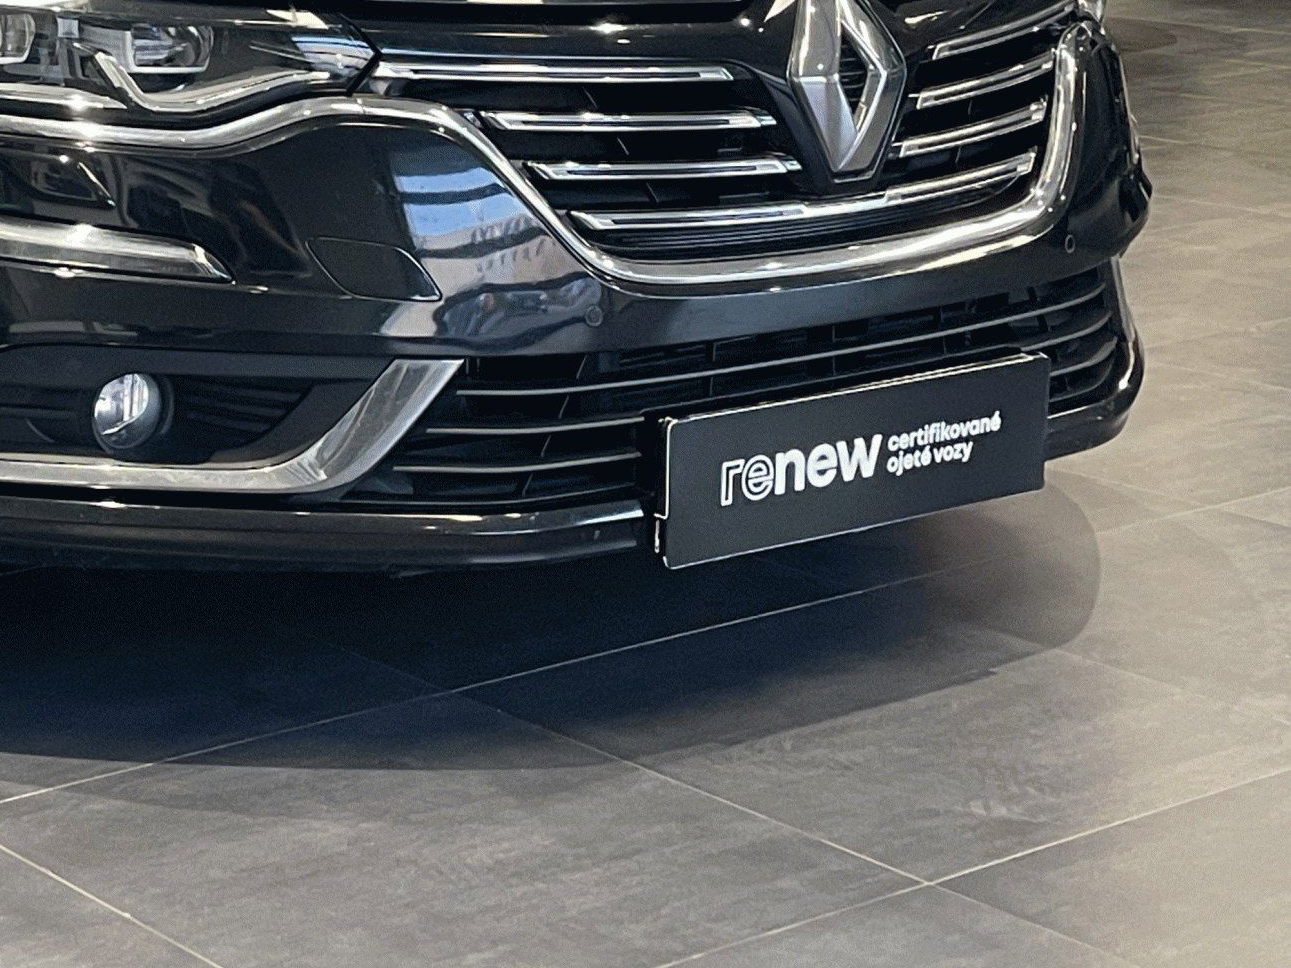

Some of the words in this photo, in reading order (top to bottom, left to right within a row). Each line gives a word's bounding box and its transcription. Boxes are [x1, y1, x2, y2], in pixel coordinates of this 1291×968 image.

[887, 410, 1002, 452] certifikované
[720, 433, 884, 507] renew
[886, 444, 932, 477] ojeté
[933, 440, 974, 463] vozy
